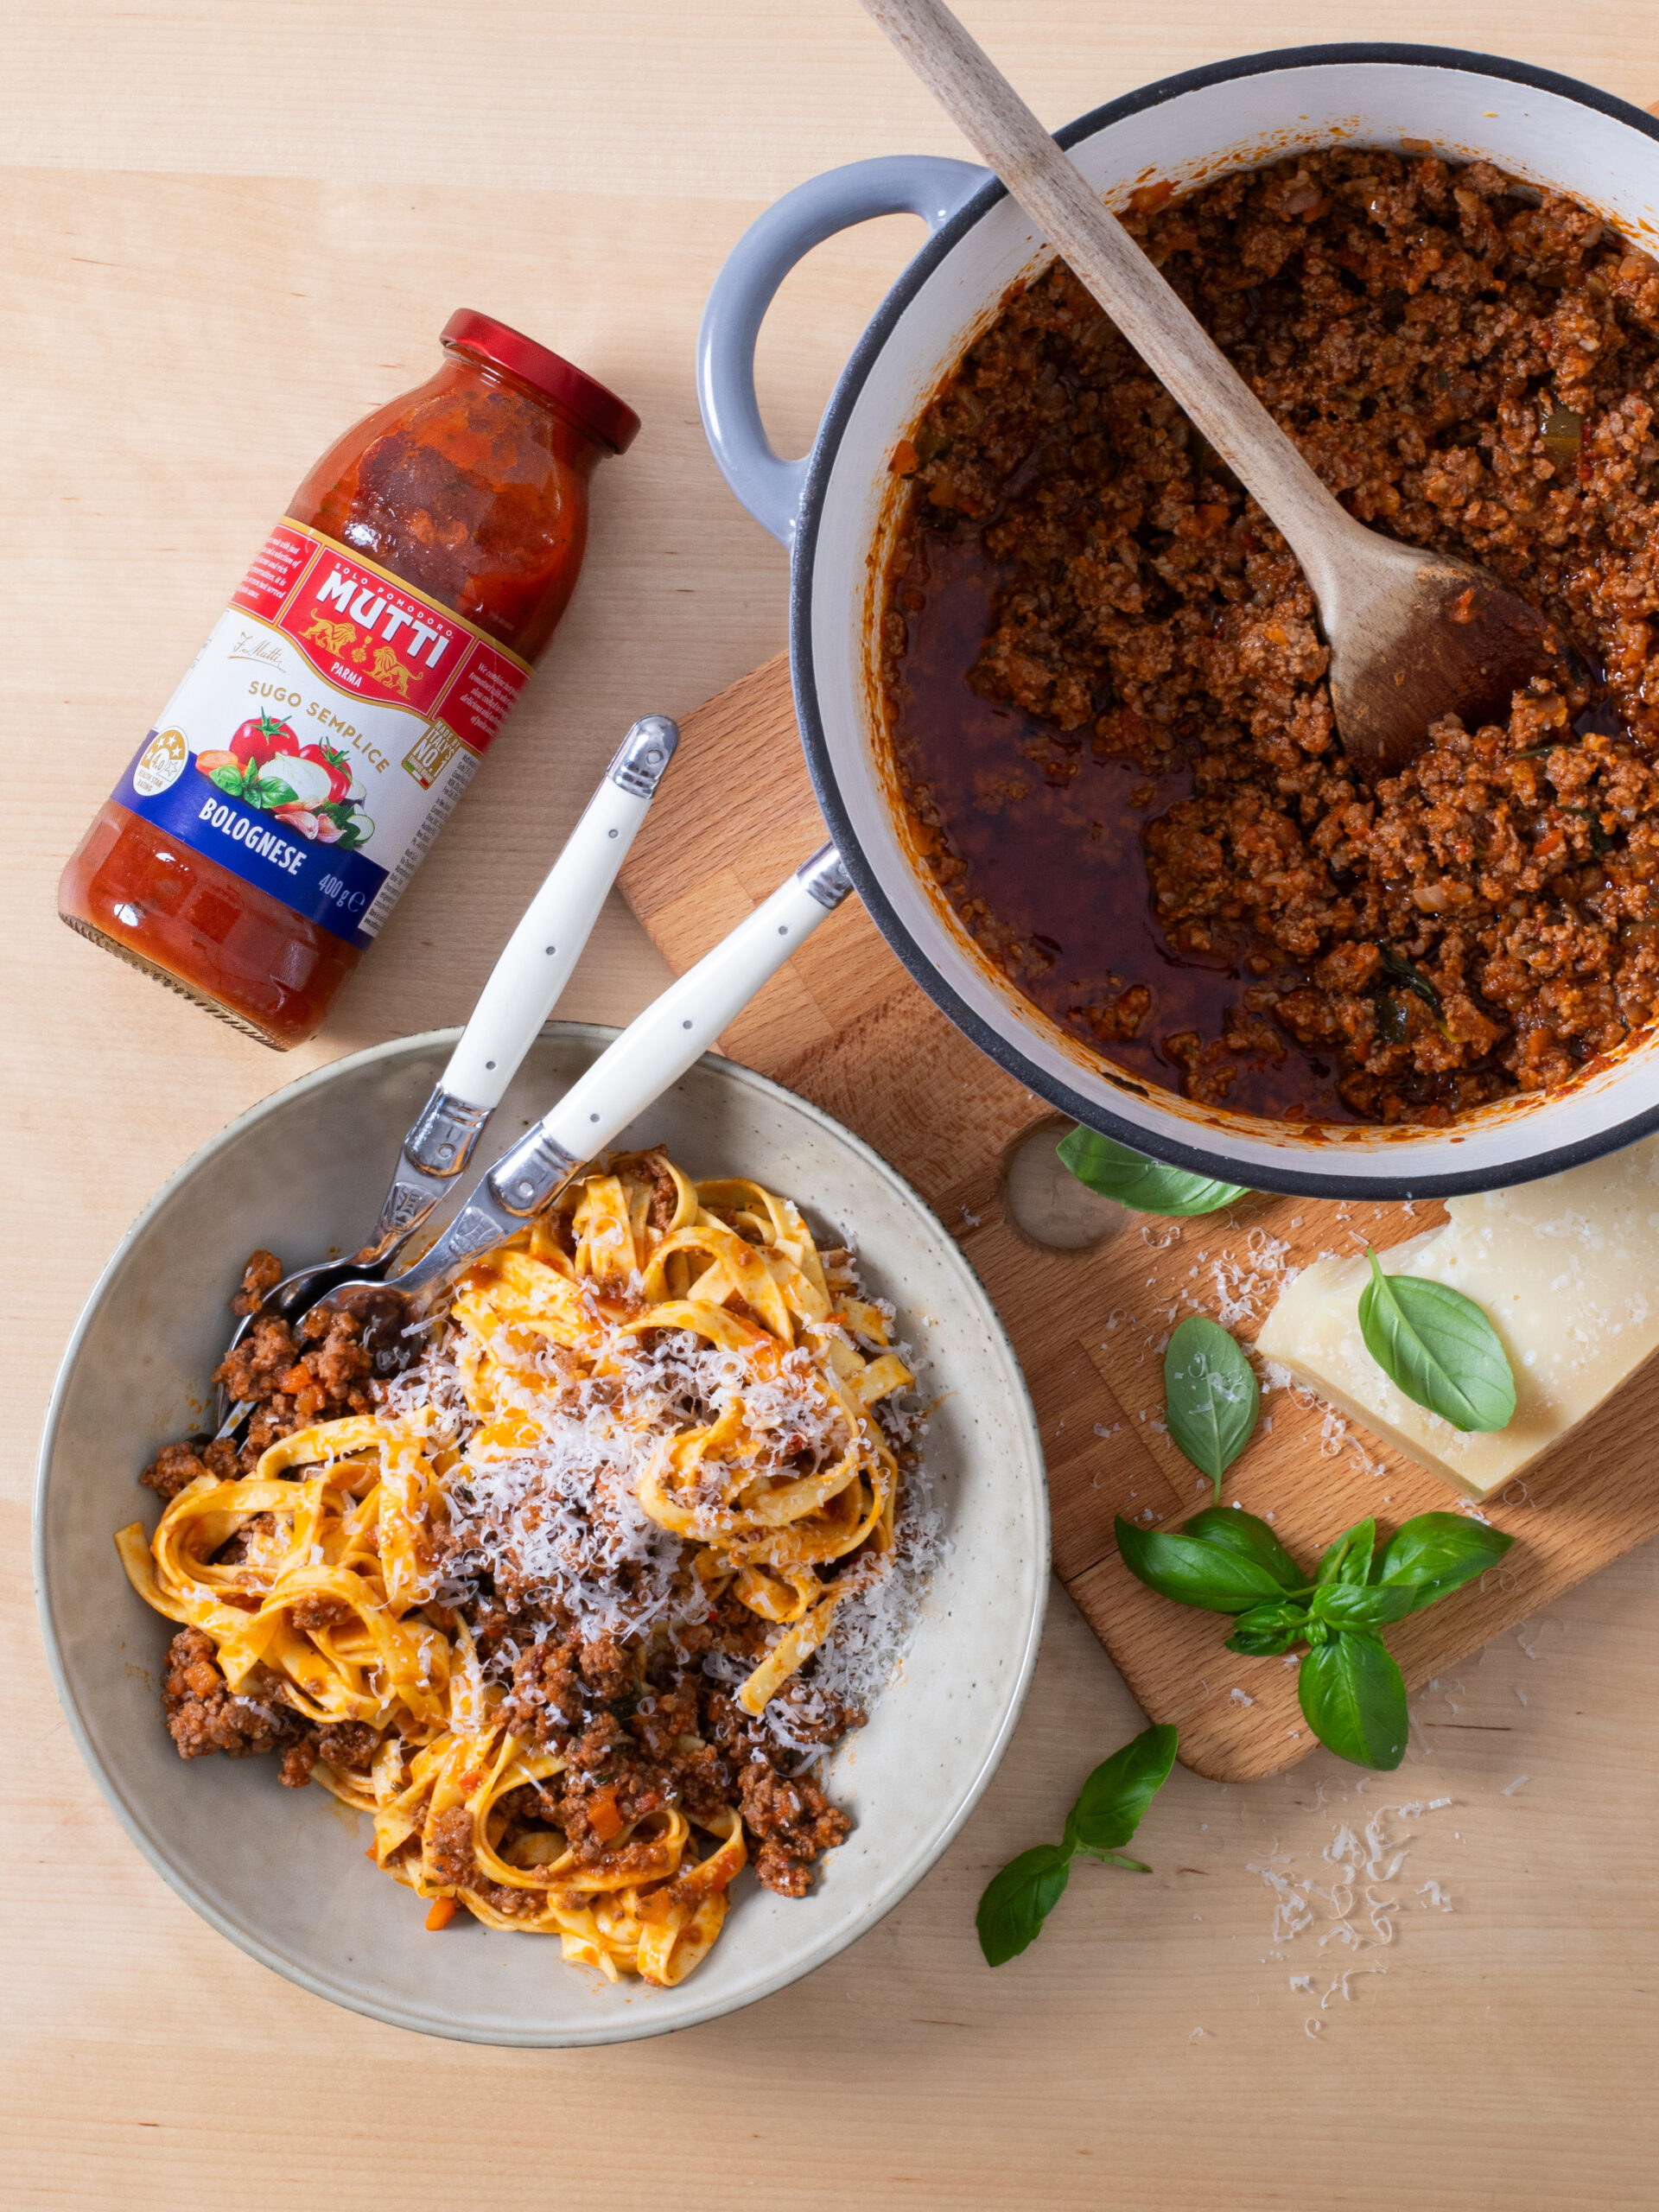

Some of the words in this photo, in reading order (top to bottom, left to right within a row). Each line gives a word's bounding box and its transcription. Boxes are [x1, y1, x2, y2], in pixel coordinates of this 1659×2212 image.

[291, 560, 302, 569] of
[334, 562, 368, 585] SOLO
[265, 586, 286, 599] served
[316, 570, 449, 668] MUTTI
[330, 661, 362, 687] PARMA
[477, 663, 487, 673] We
[468, 671, 493, 692] tomatoes
[460, 694, 483, 713] delicious
[249, 681, 302, 707] SUGO
[307, 702, 390, 773] SEMPLICE
[434, 720, 453, 741] MADE
[425, 728, 454, 760] ITALY'S
[199, 798, 307, 874] BOLOGNESE
[318, 874, 343, 898] 400
